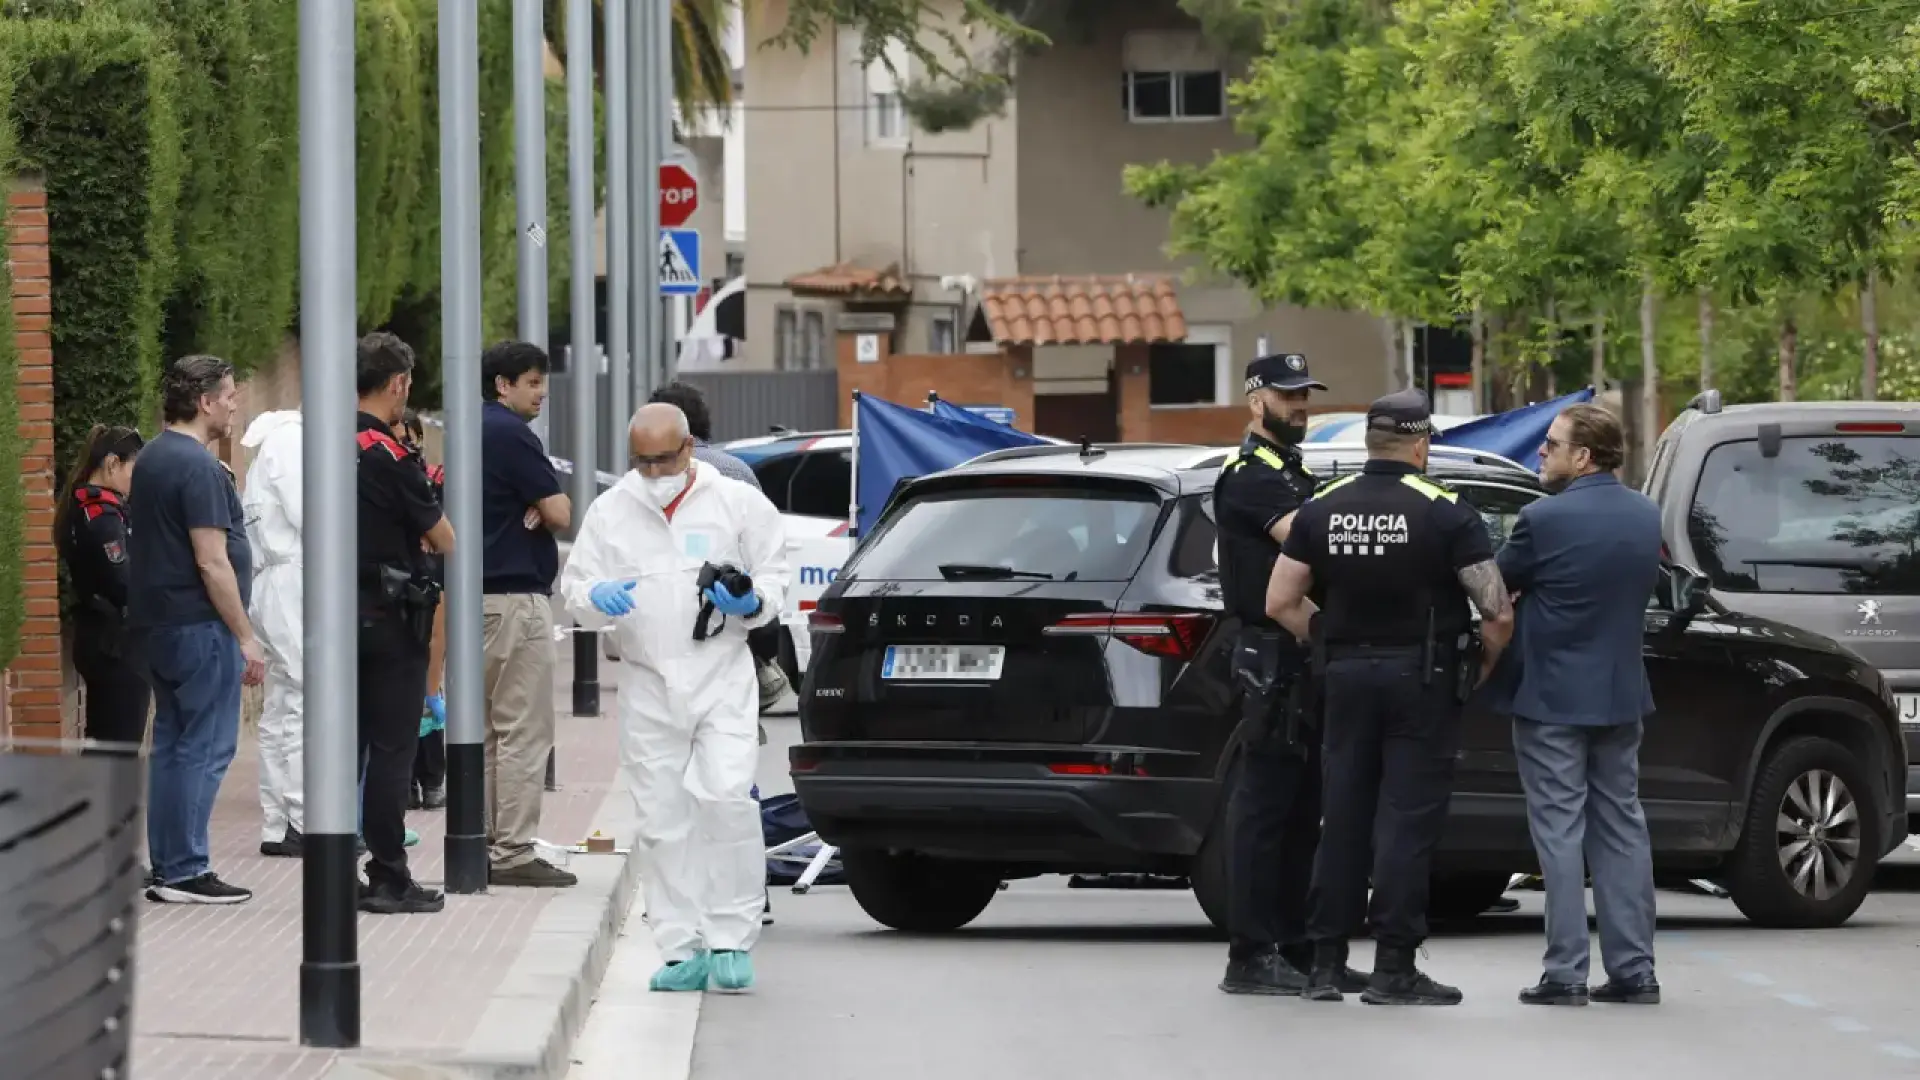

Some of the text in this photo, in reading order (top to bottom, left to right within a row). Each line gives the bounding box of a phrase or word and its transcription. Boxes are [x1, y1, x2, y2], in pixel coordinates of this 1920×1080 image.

[660, 188, 694, 204] TOP
[1329, 514, 1407, 531] POLICIA
[1329, 531, 1408, 546] policia local
